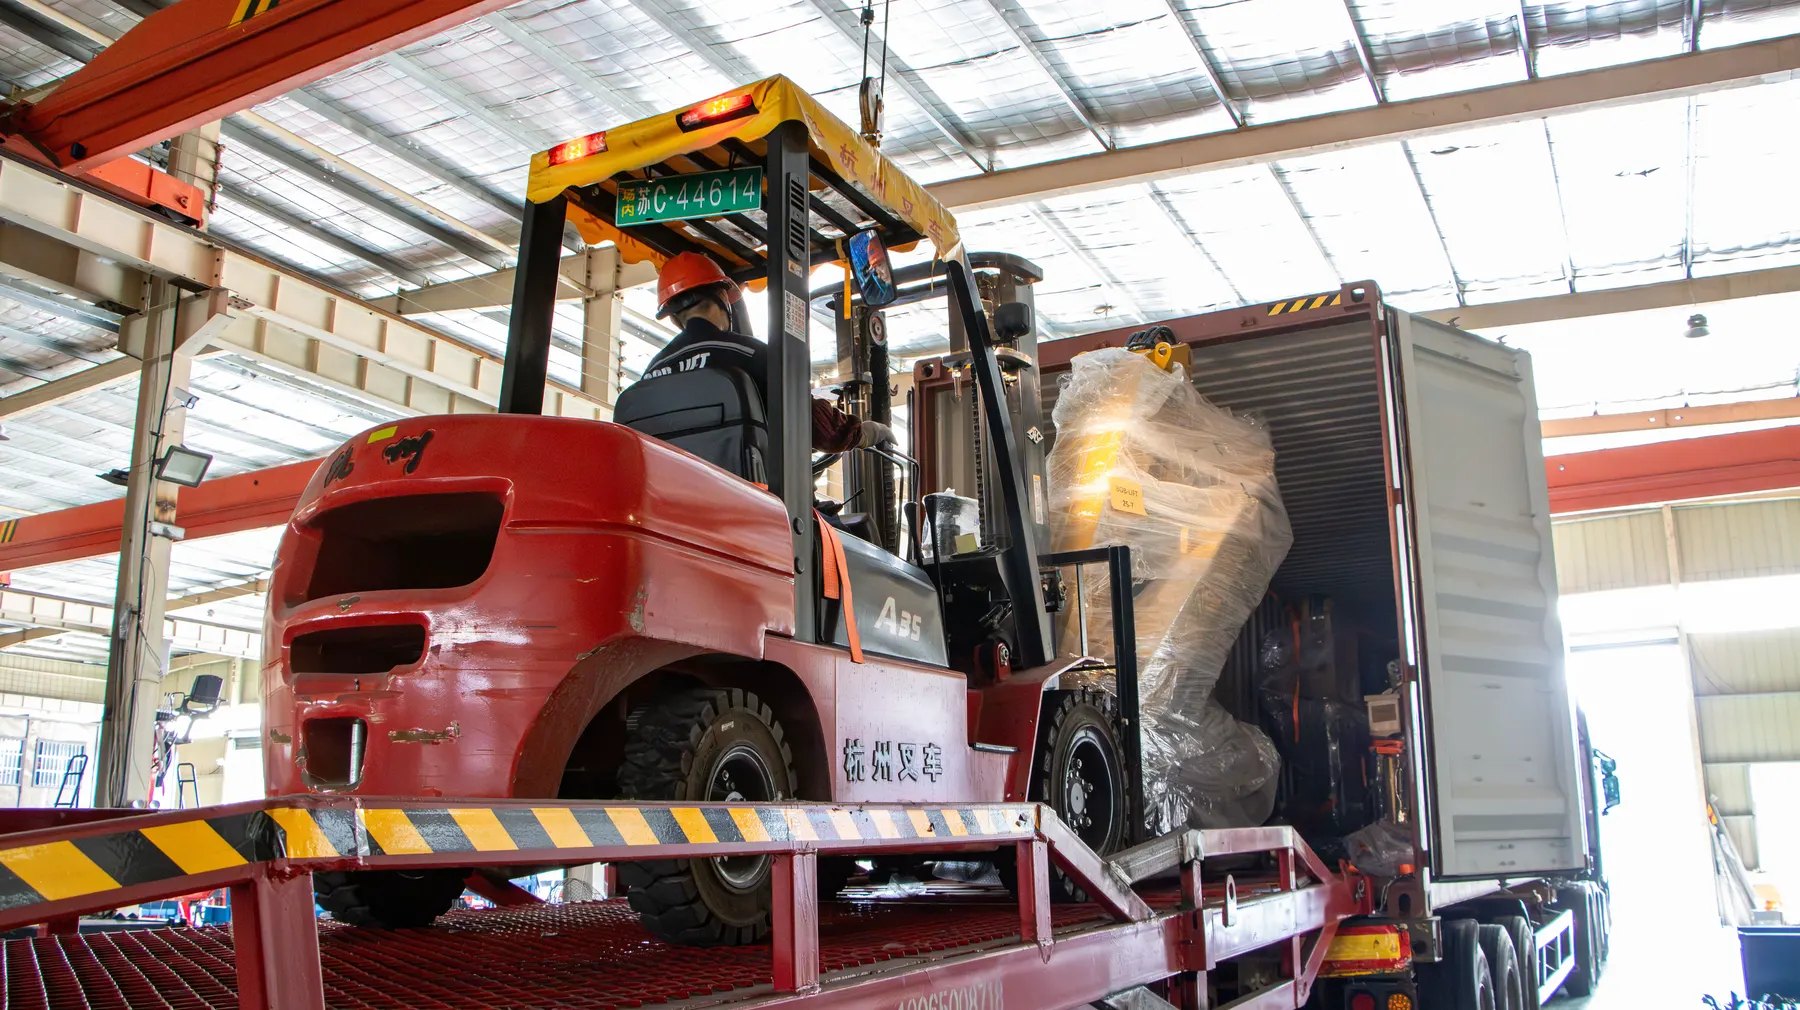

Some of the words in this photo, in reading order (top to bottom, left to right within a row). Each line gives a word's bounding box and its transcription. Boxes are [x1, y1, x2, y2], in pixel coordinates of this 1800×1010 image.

[873, 596, 922, 642] A35
[843, 738, 943, 783] 杭州叉车
